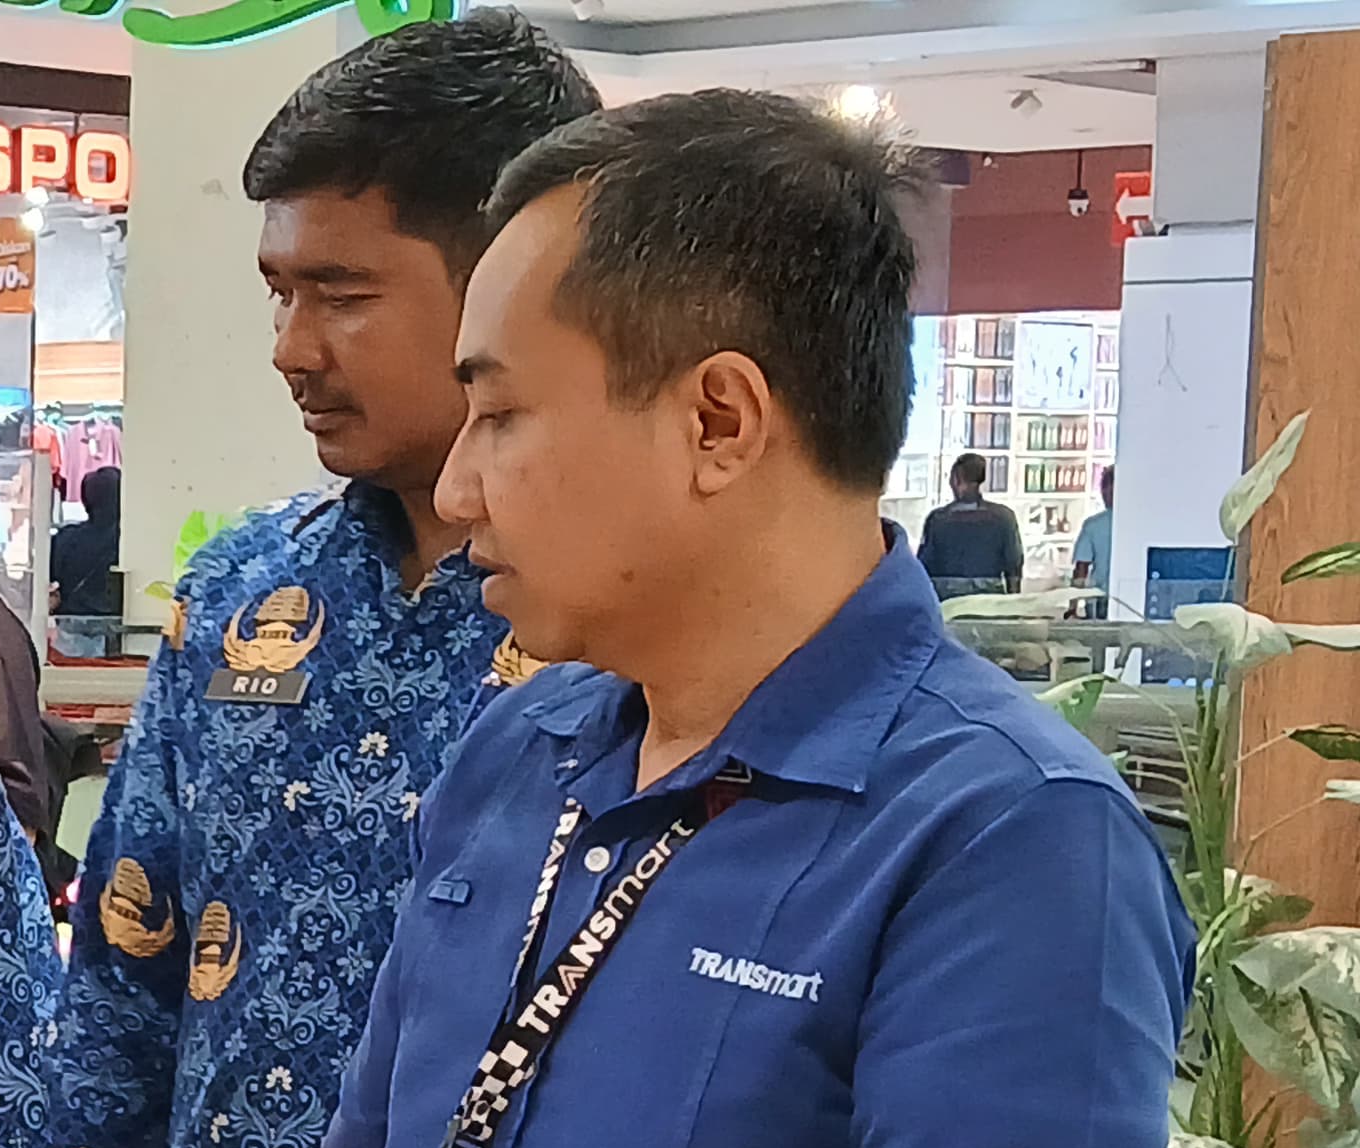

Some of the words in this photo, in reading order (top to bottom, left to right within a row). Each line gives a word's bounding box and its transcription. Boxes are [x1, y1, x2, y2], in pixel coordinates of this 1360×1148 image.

[232, 676, 278, 695] RIO
[516, 818, 696, 1035] TRANSmart
[688, 946, 824, 1003] TRANSmart
